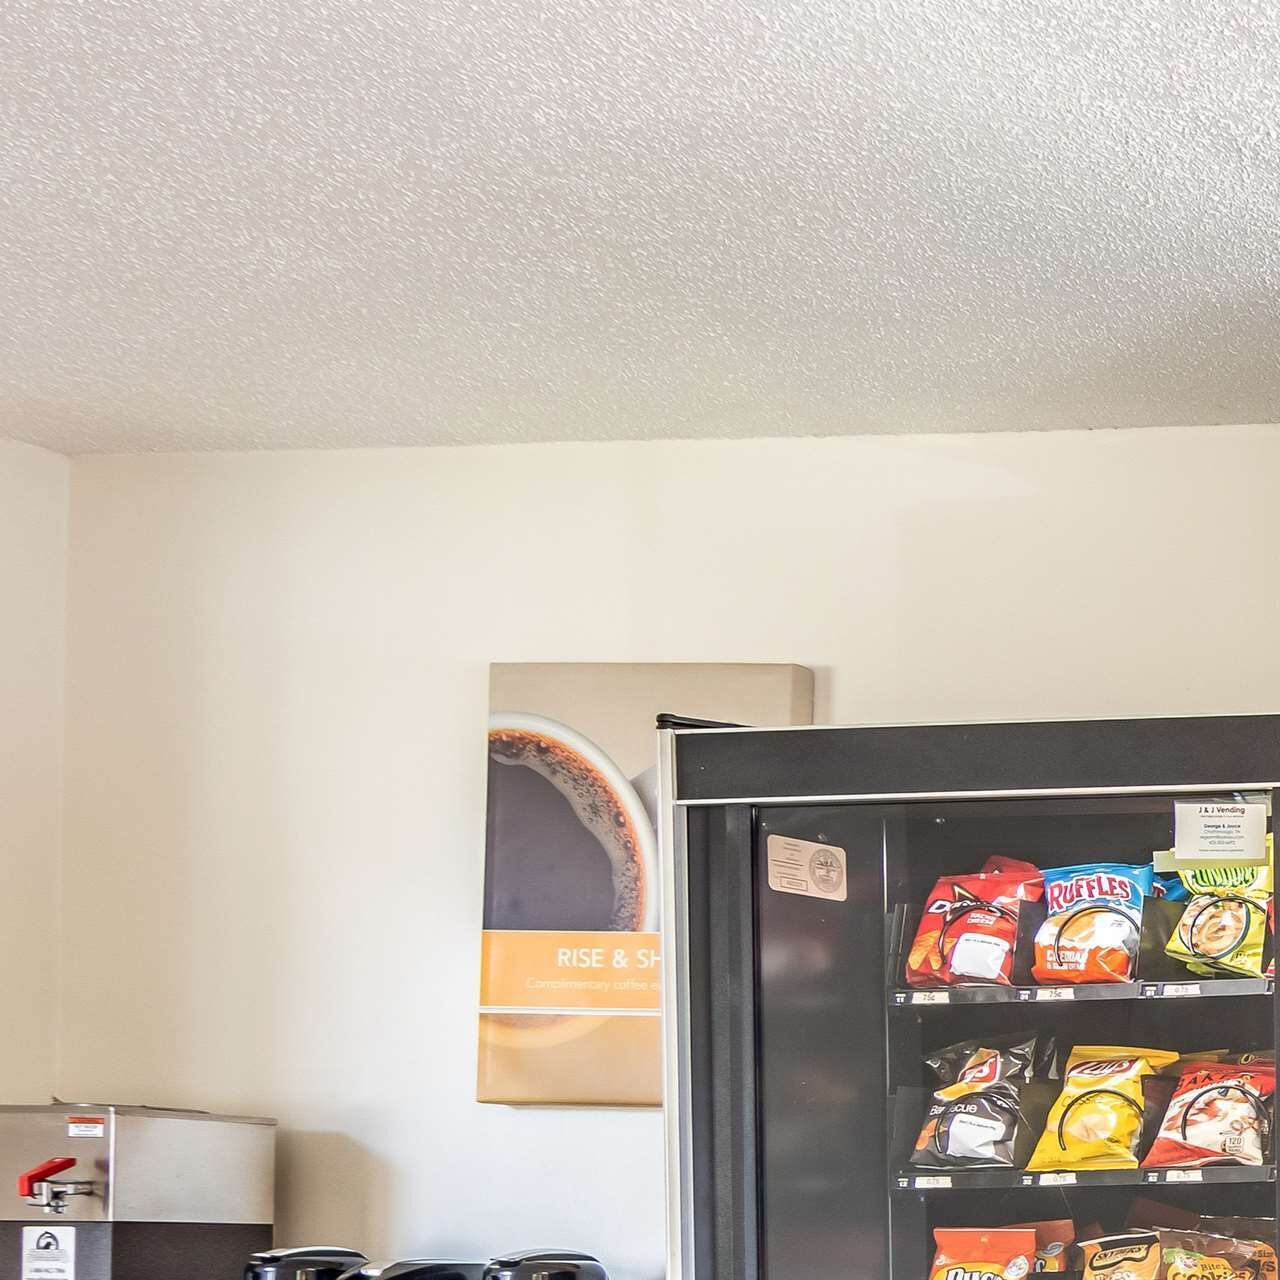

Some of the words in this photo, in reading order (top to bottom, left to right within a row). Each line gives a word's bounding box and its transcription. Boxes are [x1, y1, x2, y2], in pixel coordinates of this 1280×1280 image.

[1216, 807, 1246, 815] Vending
[1048, 873, 1131, 912] RUFFLES
[557, 948, 605, 968] RISE
[612, 948, 629, 969] &
[613, 978, 648, 992] coffee
[929, 1102, 978, 1116] Barecue
[1228, 1137, 1242, 1145] 120
